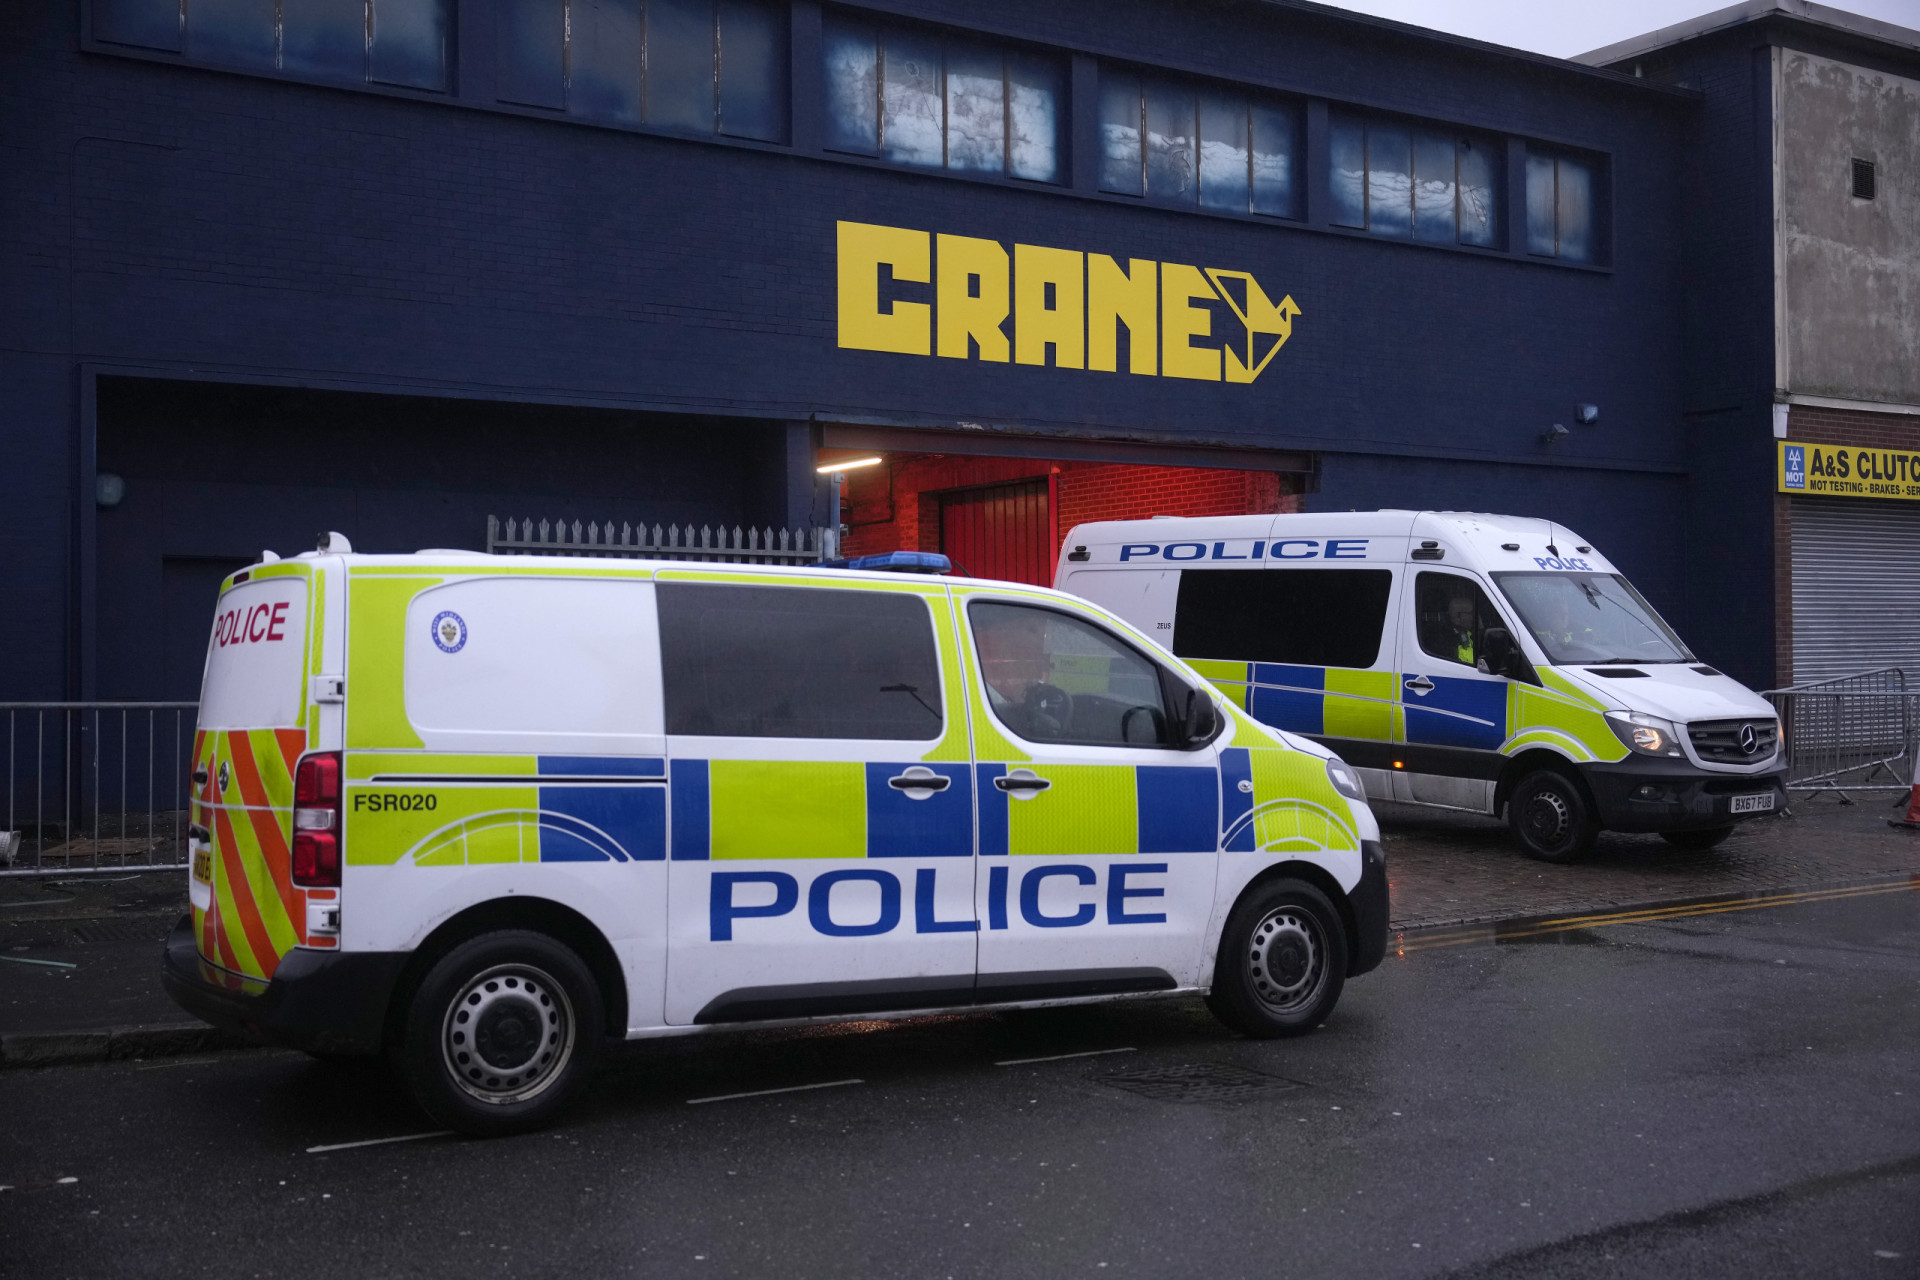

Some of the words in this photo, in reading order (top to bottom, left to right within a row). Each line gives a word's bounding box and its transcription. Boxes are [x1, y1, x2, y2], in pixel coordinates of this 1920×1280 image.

[837, 220, 1221, 381] CRANE
[1810, 448, 1850, 478] A&S
[1856, 451, 1920, 483] CLUTC
[1785, 471, 1804, 483] MOT
[1810, 479, 1827, 490] MOT
[1829, 480, 1863, 492] TESTING
[1870, 483, 1900, 495] BRAKES
[1119, 539, 1369, 562] POLICE
[1533, 557, 1593, 571] POLICE
[215, 602, 290, 648] POLICE
[1157, 622, 1172, 630] ZEUS
[354, 794, 437, 812] FSR020
[1735, 797, 1756, 811] BX67
[710, 863, 1168, 942] POLICE
